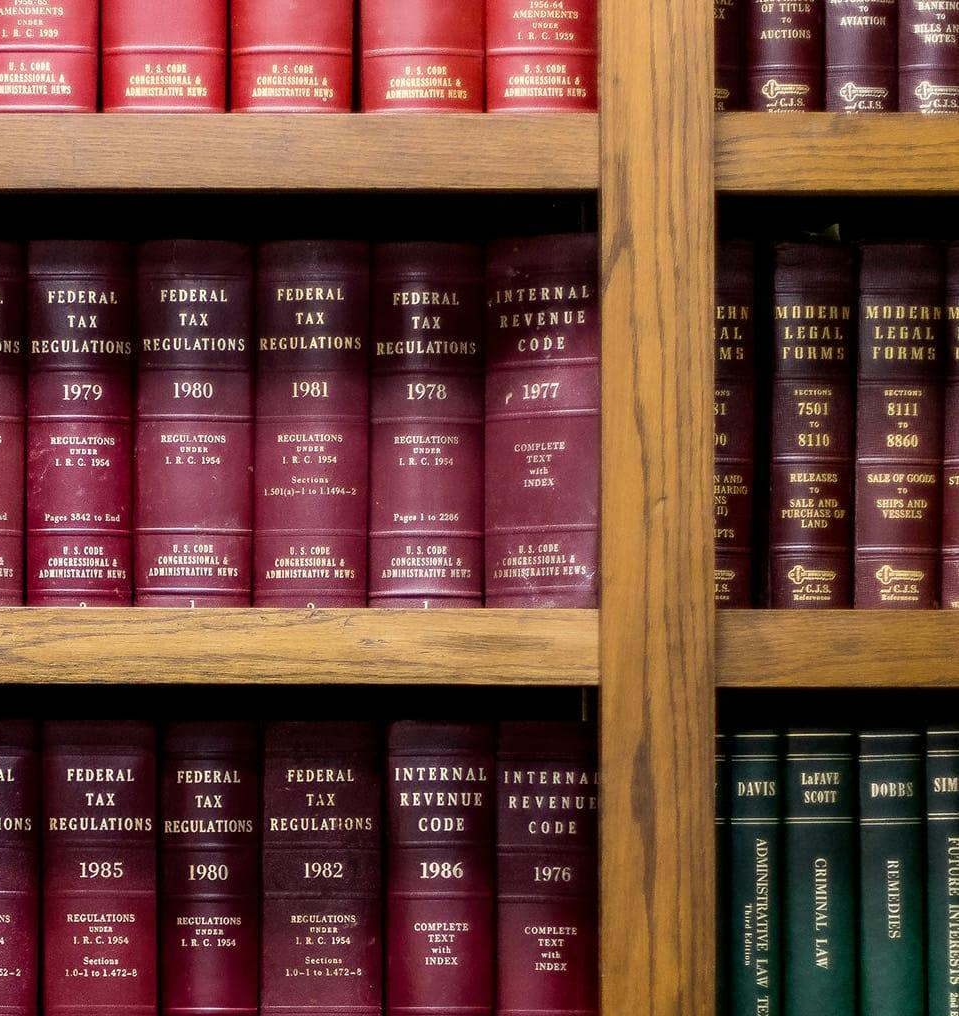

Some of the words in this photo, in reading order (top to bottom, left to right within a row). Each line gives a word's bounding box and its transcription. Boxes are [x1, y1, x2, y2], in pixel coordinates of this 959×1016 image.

[513, 10, 579, 19] AMENDMENTS
[761, 4, 776, 12] OF
[780, 4, 811, 12] TITLE
[840, 17, 886, 26] AVIATION
[2, 29, 8, 37] I.
[13, 29, 21, 37] R.
[26, 29, 34, 37] C.
[40, 29, 59, 37] 1939
[761, 30, 811, 40] AUCTIONS
[925, 34, 955, 43] NOTES
[496, 285, 590, 302] INTERNAL
[500, 310, 586, 327] REVENUE
[775, 306, 850, 320] MODERN
[865, 306, 941, 320] MODERN
[785, 326, 843, 339] LEGAL
[875, 326, 934, 340] LEGAL
[518, 335, 566, 352] CODE
[783, 347, 845, 360] FORMS
[873, 347, 936, 360] FORMS
[63, 384, 103, 400] 1979
[173, 382, 213, 398] 1980
[291, 382, 329, 398] 1981
[522, 383, 560, 400] 1977
[798, 402, 829, 415] 7501
[887, 402, 918, 415] 8111
[514, 441, 566, 452] COMPLETE
[798, 434, 829, 447] 8110
[887, 434, 918, 447] 8860
[527, 454, 552, 464] TEXT
[529, 466, 550, 475] with
[291, 476, 328, 484] Sections
[523, 478, 554, 488] INDEX
[790, 474, 837, 482] RELEASES
[867, 475, 891, 483] SALE
[893, 475, 904, 483] OF
[907, 475, 935, 483] GOODS
[790, 499, 814, 507] SALE
[818, 499, 838, 507] AND
[877, 499, 904, 508] SHIPS
[907, 499, 927, 508] AND
[781, 510, 831, 518] PURCHASE
[834, 510, 846, 518] OF
[882, 510, 922, 519] VESSELS
[801, 520, 828, 528] LAND
[395, 768, 487, 781] INTERNAL
[801, 772, 840, 786] LaFAVE
[738, 782, 776, 796] DAVIS
[871, 783, 913, 797] DOBBS
[400, 793, 483, 807] REVENUE
[804, 790, 837, 803] SCOTT
[419, 818, 465, 832] CODE
[79, 861, 123, 878] 1985
[187, 864, 228, 880] 1980
[304, 862, 343, 878] 1982
[419, 862, 464, 879] 1986
[534, 866, 571, 882] 1976
[756, 838, 769, 951] ADMINISTRATIVE
[813, 858, 827, 931] CRIMINAL
[887, 860, 901, 939] REMEDIES
[744, 904, 752, 930] Third
[414, 922, 469, 931] COMPLETE
[425, 956, 458, 965] INDEX
[816, 938, 827, 970] LAW
[756, 959, 768, 988] LAW
